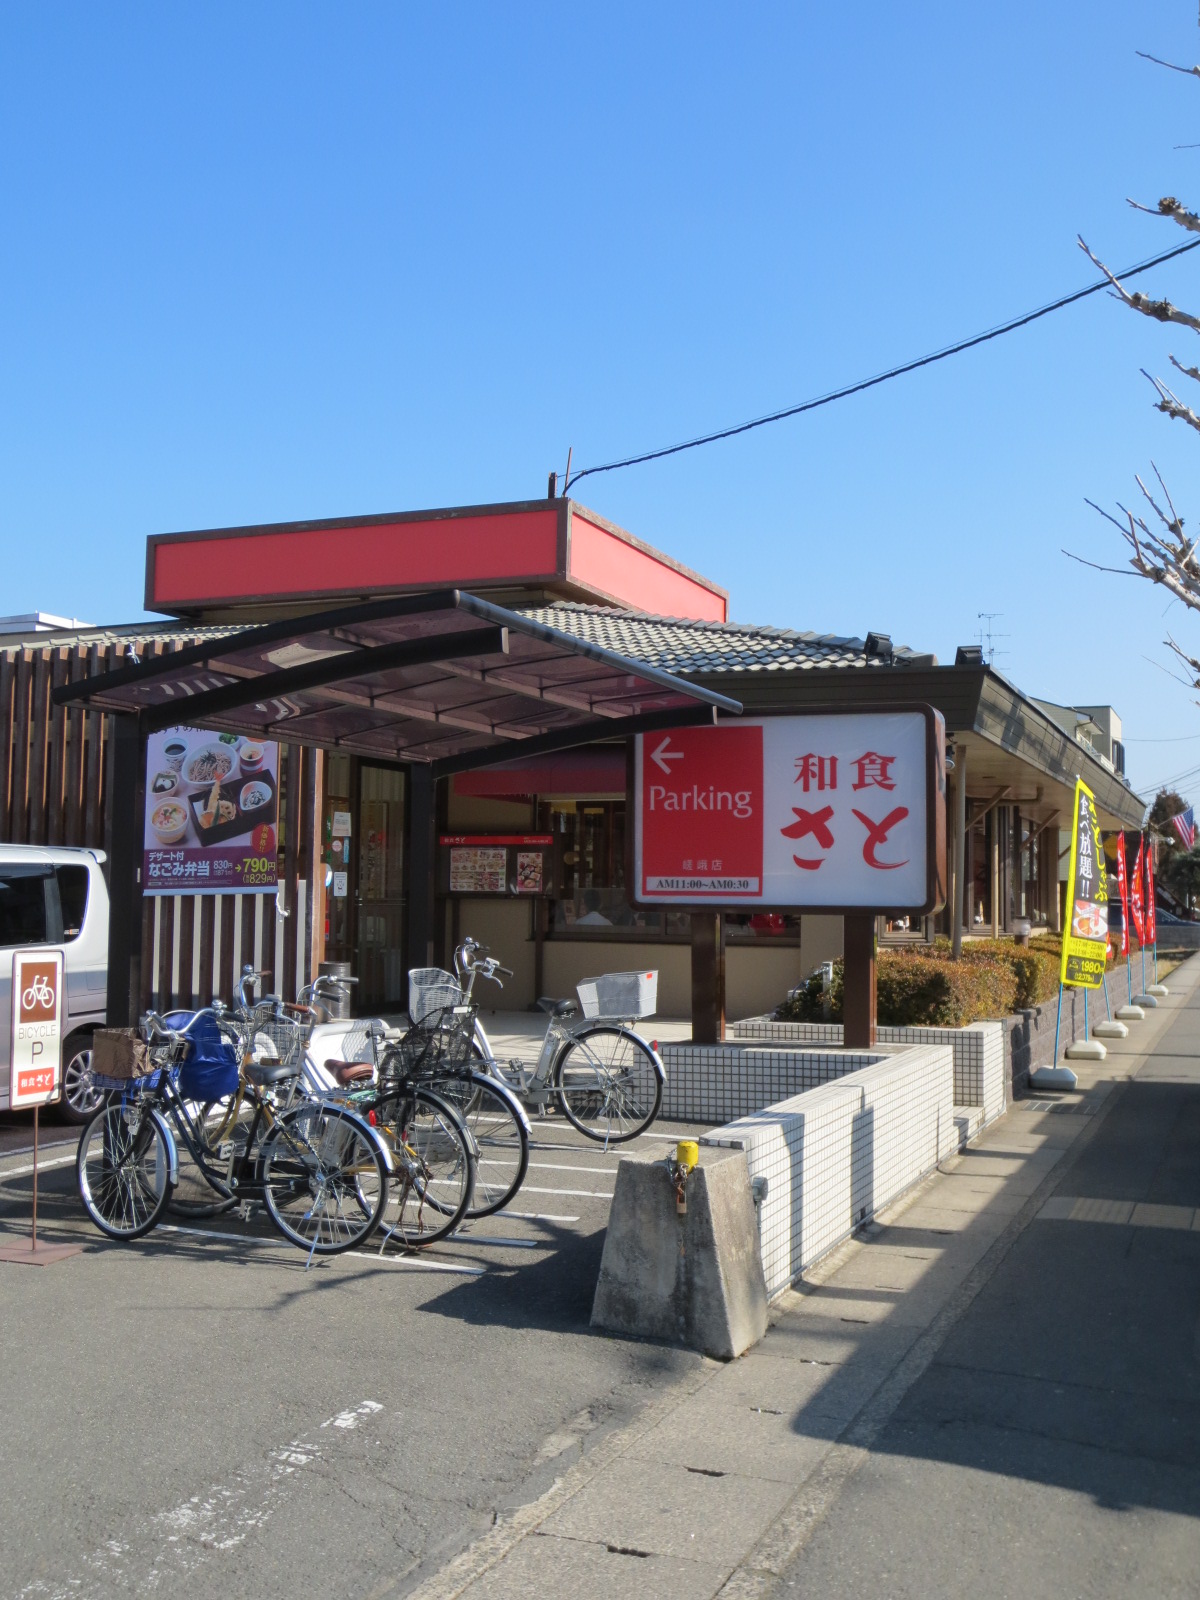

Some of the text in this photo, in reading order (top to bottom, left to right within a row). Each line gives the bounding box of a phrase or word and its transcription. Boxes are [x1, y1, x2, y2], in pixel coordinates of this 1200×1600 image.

[793, 751, 897, 793] 和食
[649, 785, 753, 819] Parking
[780, 805, 911, 871] さと
[148, 850, 185, 861] デザート付
[148, 860, 210, 877] なごみ弁当
[242, 857, 276, 873] 790円
[682, 859, 724, 872] 嵯峨店
[18, 1025, 57, 1040] BICYCLE
[31, 1041, 44, 1065] P
